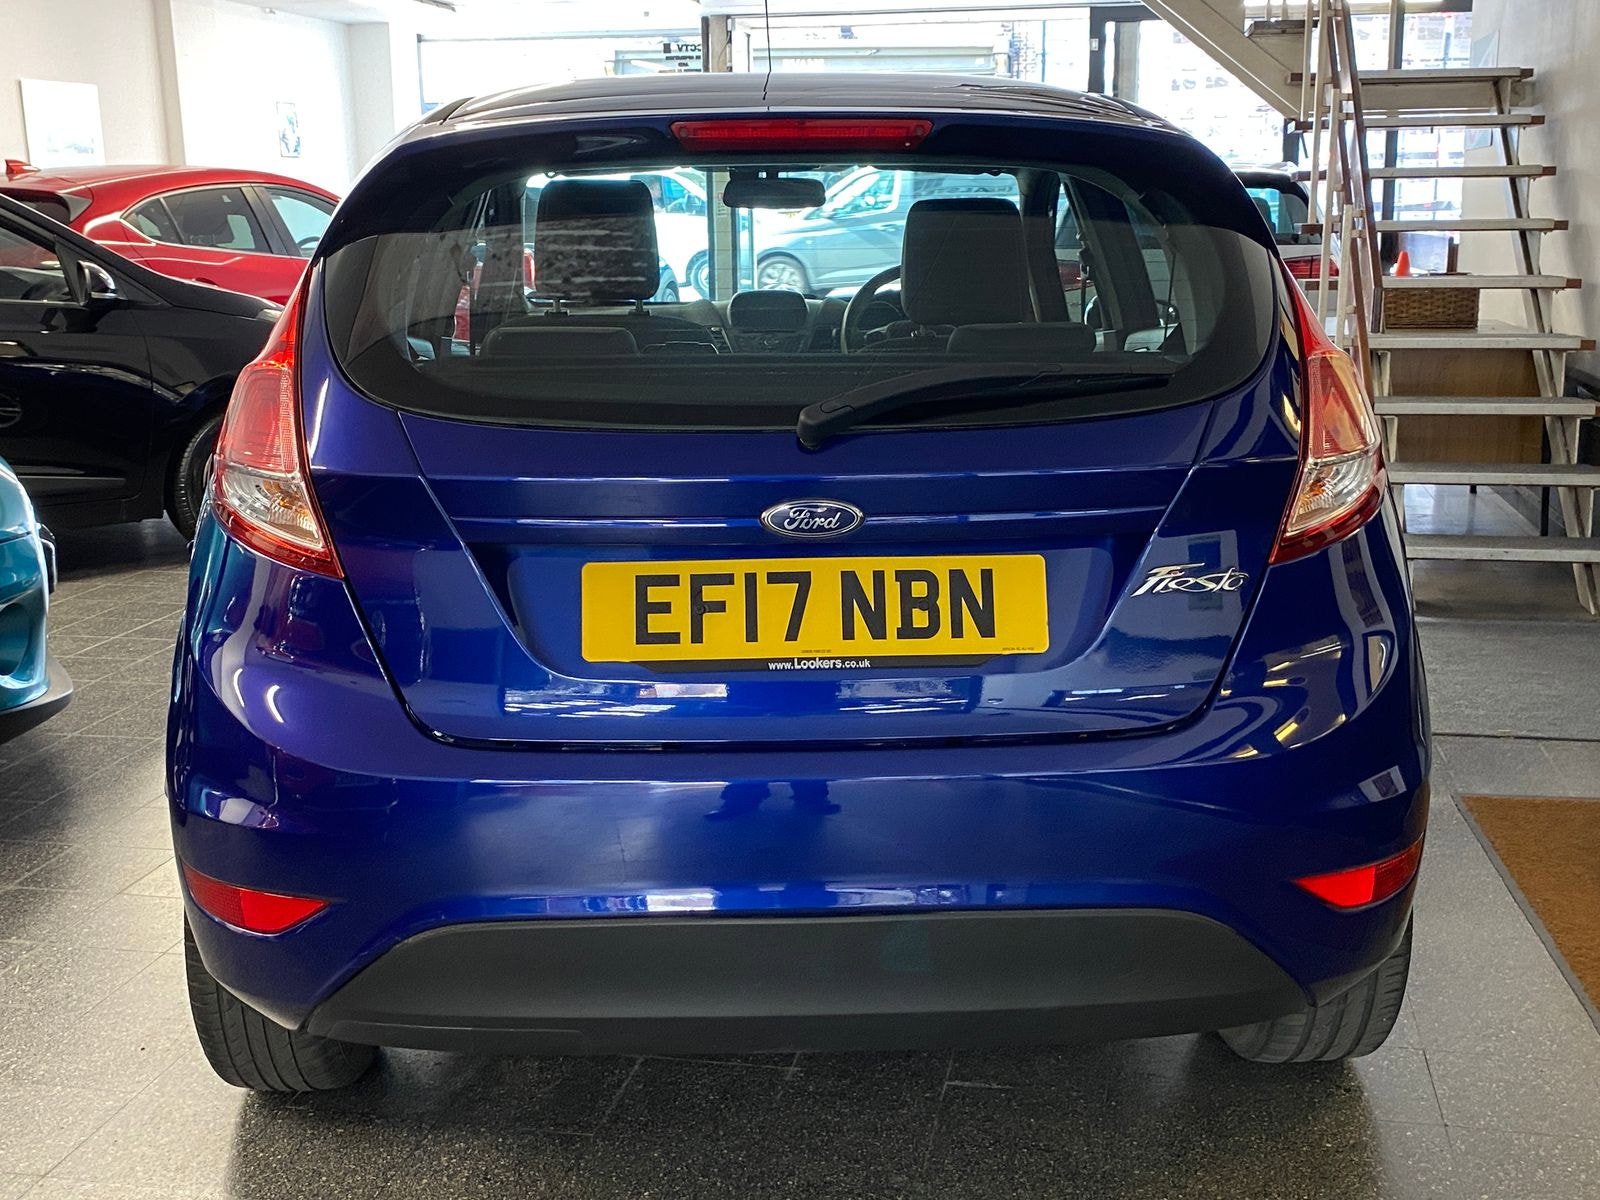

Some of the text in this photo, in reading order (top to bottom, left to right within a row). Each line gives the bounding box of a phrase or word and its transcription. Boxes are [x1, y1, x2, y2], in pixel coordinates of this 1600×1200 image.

[783, 507, 841, 530] Ford
[1131, 562, 1249, 598] Fiesta
[635, 568, 996, 645] EF17 NBN
[768, 657, 871, 670] www.Lookers.co.uk
